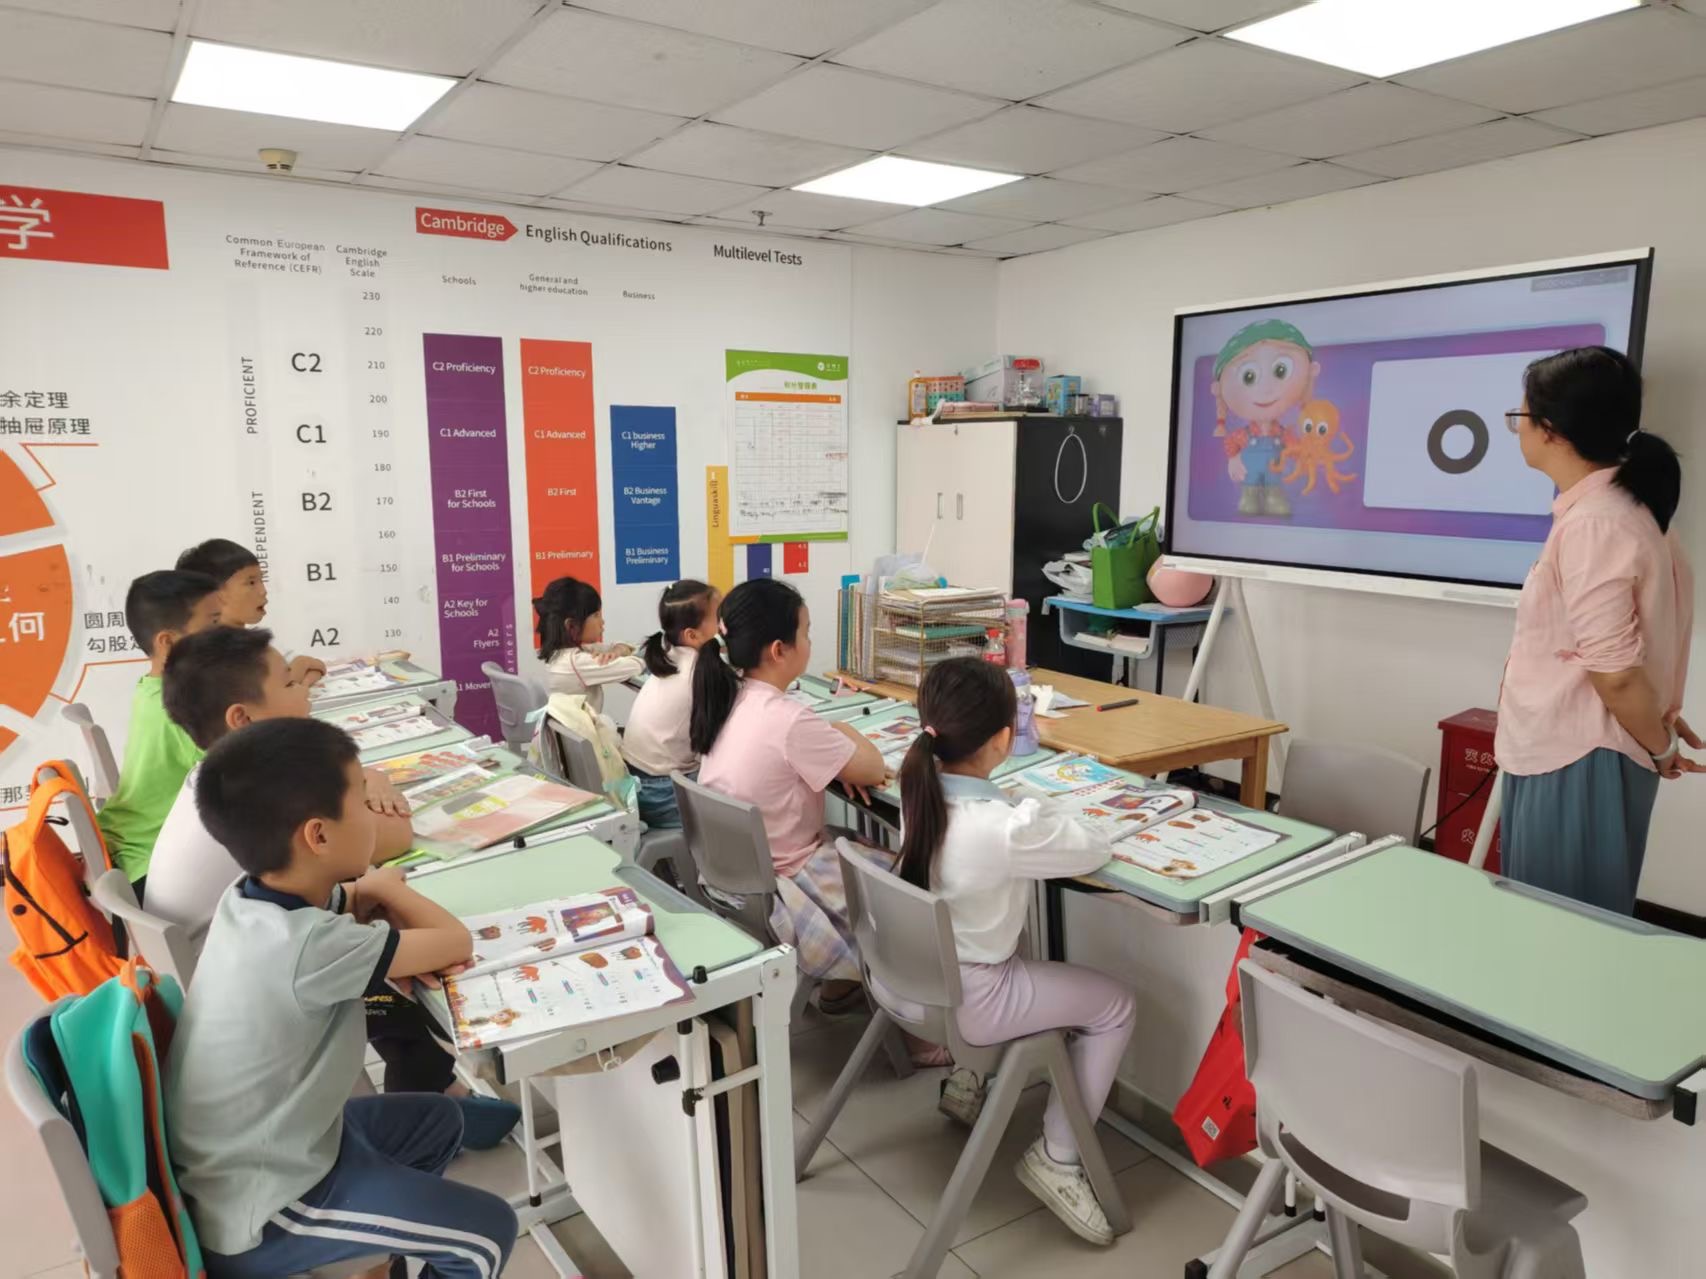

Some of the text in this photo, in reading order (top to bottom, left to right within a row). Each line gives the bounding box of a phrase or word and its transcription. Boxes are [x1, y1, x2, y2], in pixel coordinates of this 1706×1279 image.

[0, 194, 55, 250] 学
[420, 212, 672, 252] Cambridge English Qualifications
[225, 235, 326, 252] Common European
[240, 247, 311, 262] Framework of
[335, 244, 388, 259] Cambridge
[713, 244, 802, 267] Multilevel Tests
[234, 259, 323, 275] Reference (CEFR)
[345, 256, 380, 268] English
[350, 268, 376, 278] Scale
[441, 275, 477, 286] Schools
[528, 273, 579, 286] General and
[519, 283, 589, 297] higher education
[622, 290, 656, 300] Business
[362, 291, 381, 301] 230
[364, 326, 383, 337] 220
[290, 351, 324, 373] C2
[367, 360, 386, 370] 210
[432, 361, 496, 375] C2 Proficiency
[528, 366, 586, 379] C2 Proficiency
[0, 389, 70, 409] 余定理
[240, 356, 259, 434] PROFICIENT
[369, 394, 388, 404] 200
[0, 416, 92, 435] 抽屉原理
[295, 423, 328, 444] C1
[371, 428, 390, 439] 190
[440, 428, 497, 439] C1 Advanced
[534, 430, 586, 440] C1 Advanced
[621, 432, 631, 440] C1
[631, 440, 656, 451] Higher
[374, 462, 392, 472] 180
[454, 489, 487, 498] B2 First
[547, 487, 577, 497] B2 First
[623, 486, 667, 496] B2 Business
[301, 491, 333, 512] B2
[376, 496, 394, 506] 170
[447, 498, 496, 509] for Schools
[631, 496, 661, 507] Vantage
[251, 490, 270, 583] INDEPENDENT
[378, 529, 396, 540] 160
[535, 550, 594, 562] B1 Preliminary
[625, 547, 668, 556] B1 Business
[442, 552, 506, 565] B1 Preliminary
[626, 555, 668, 566] Preliminary
[306, 562, 337, 582] B1
[380, 563, 398, 573] 150
[451, 562, 500, 573] for Schools
[383, 596, 400, 605] 140
[444, 598, 488, 611] A2 Key for
[444, 608, 479, 619] Schools
[84, 611, 126, 630] 圆周
[310, 628, 341, 648] A2
[385, 629, 402, 638] 130
[487, 628, 499, 638] A2
[473, 638, 500, 649] Flyers
